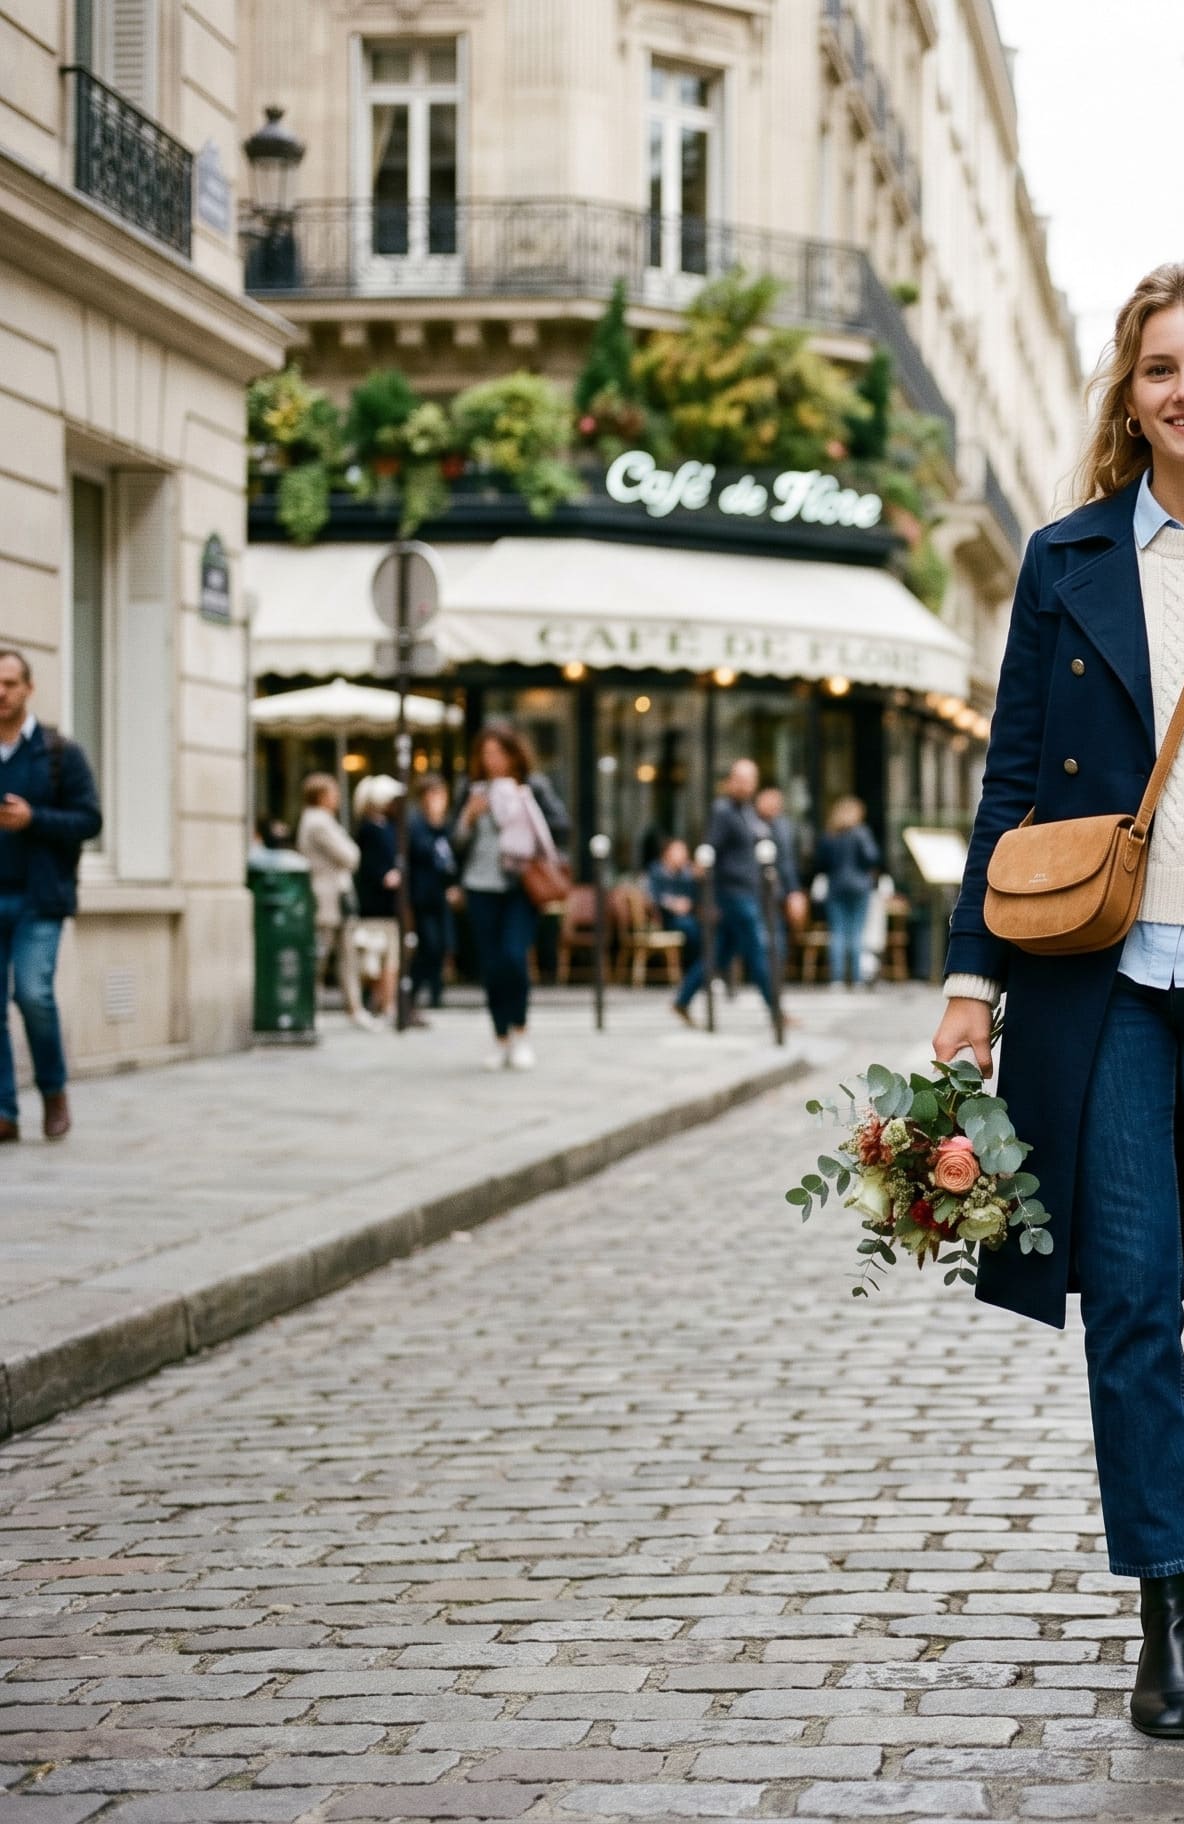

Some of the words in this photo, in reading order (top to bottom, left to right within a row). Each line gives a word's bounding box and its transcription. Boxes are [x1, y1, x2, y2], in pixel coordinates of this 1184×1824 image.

[606, 450, 717, 518] Café
[719, 475, 768, 516] de
[723, 632, 790, 661] DE
